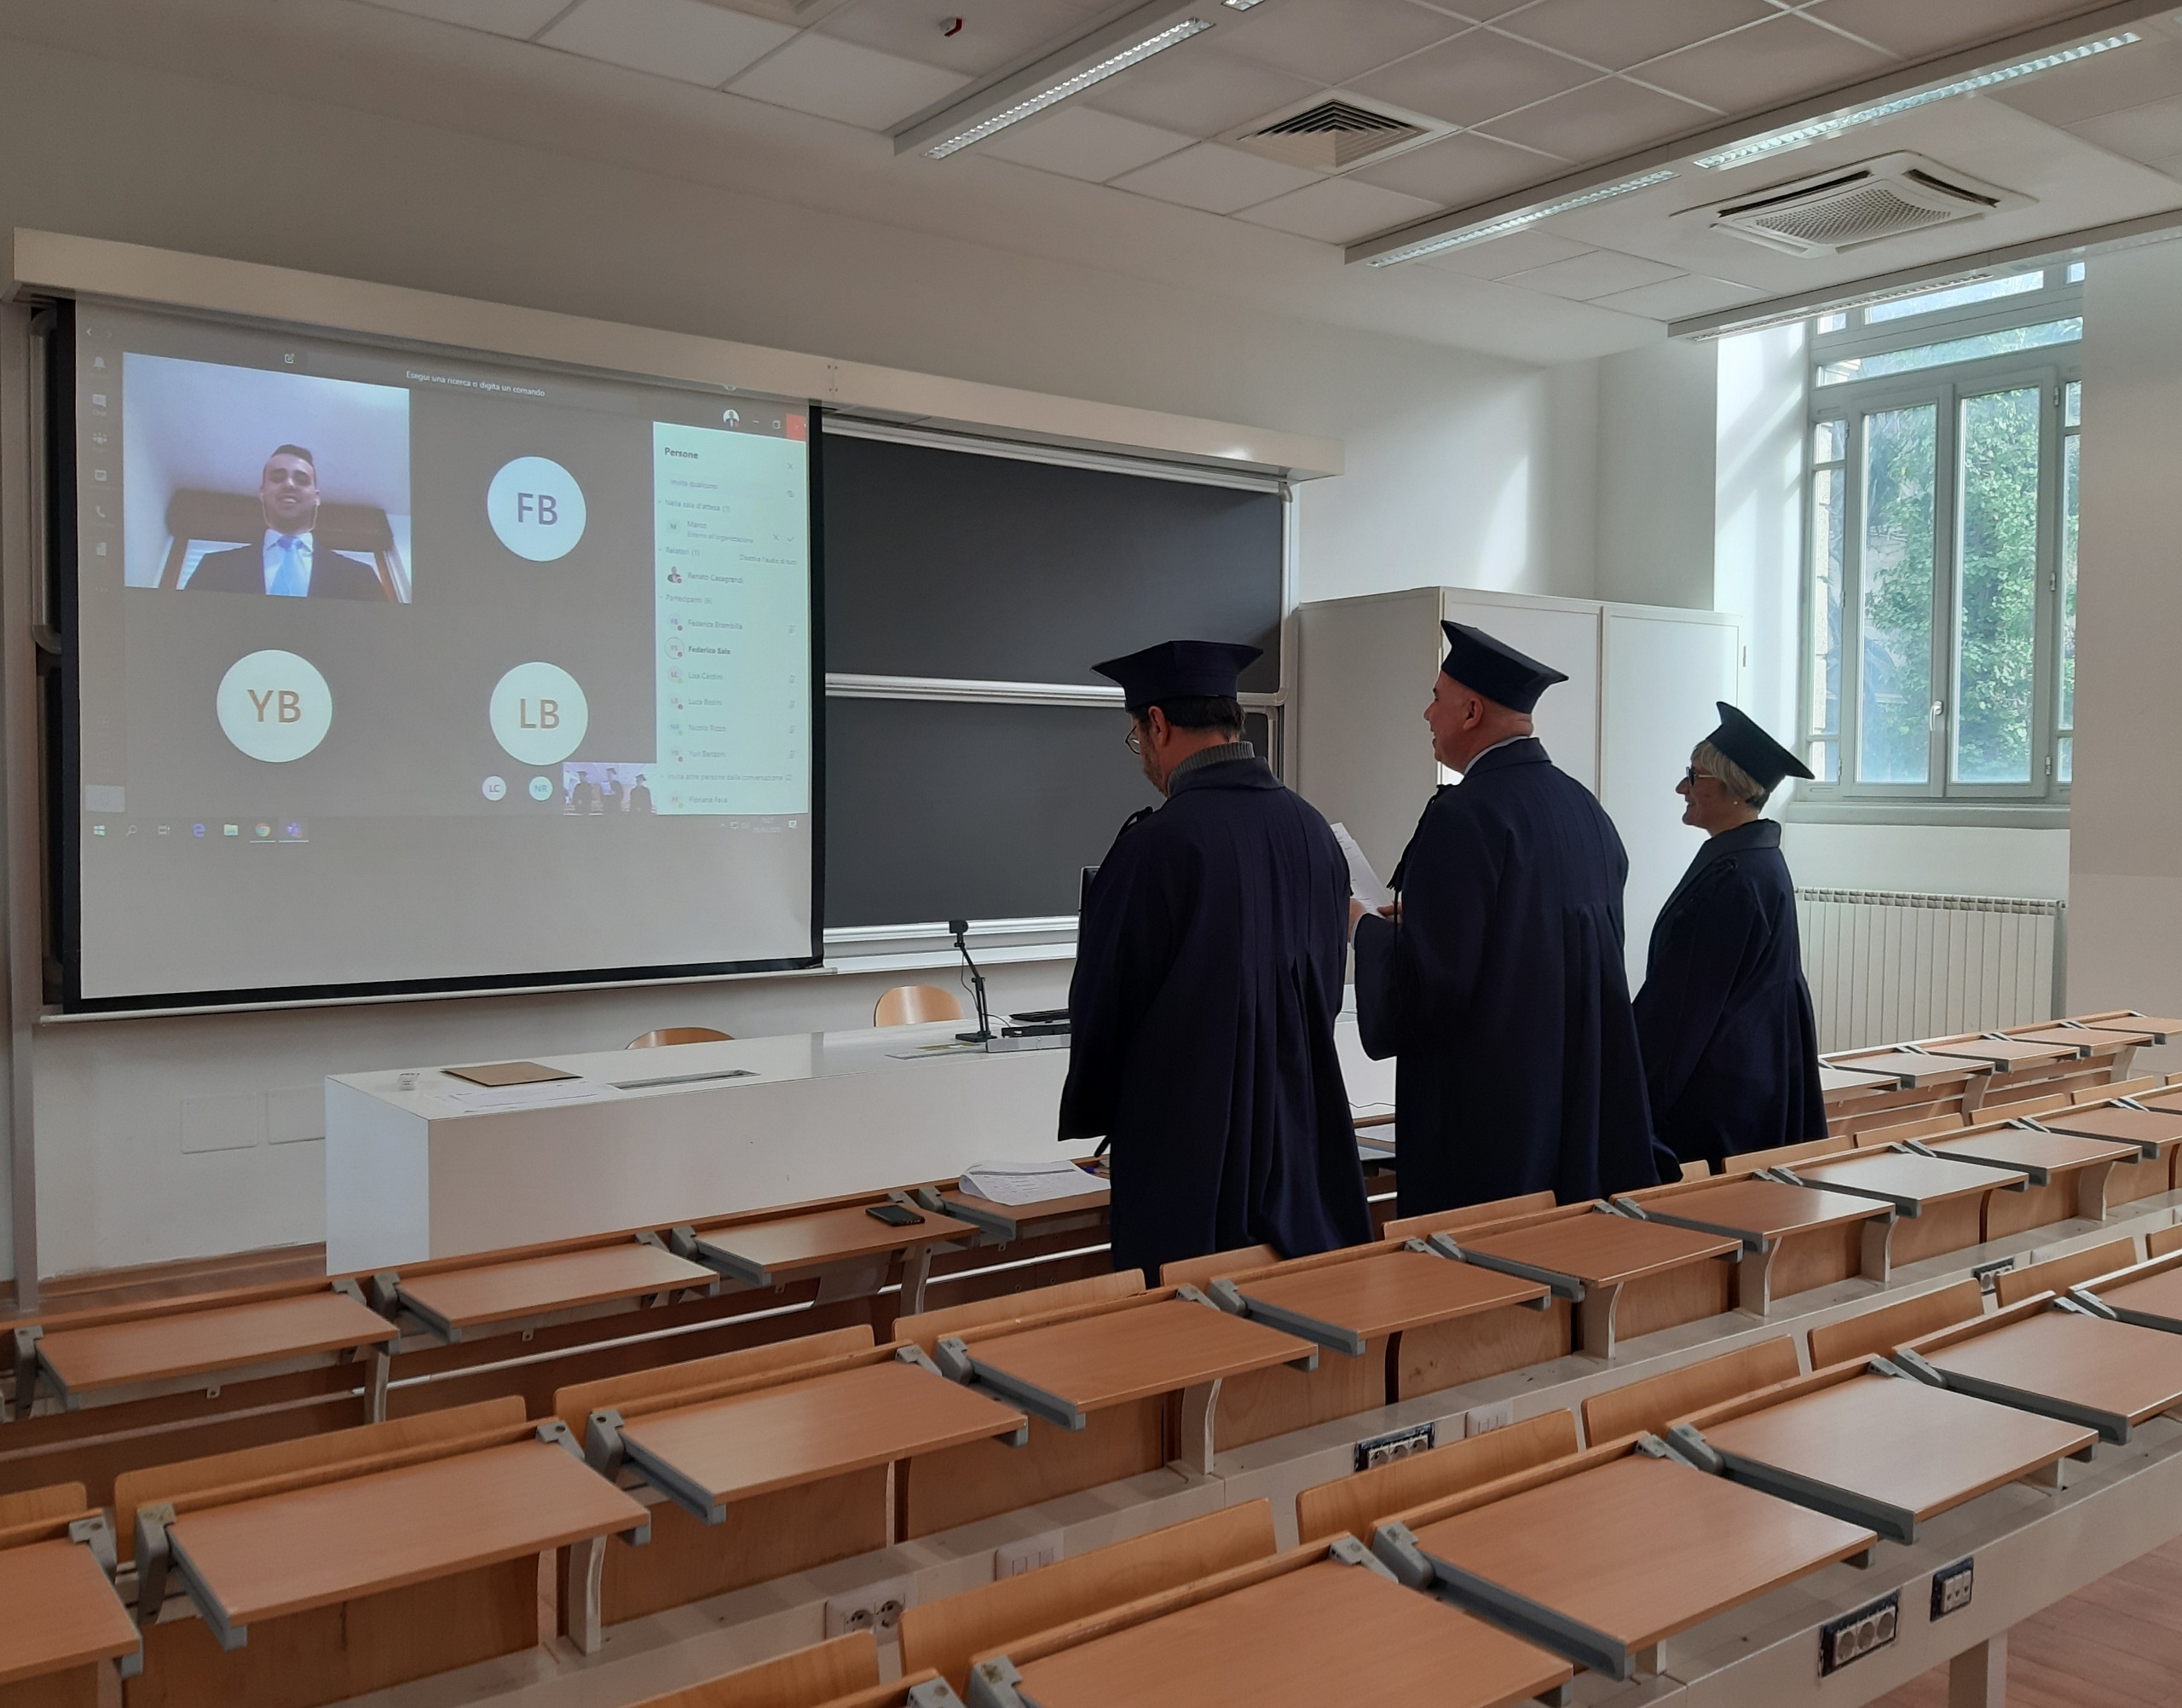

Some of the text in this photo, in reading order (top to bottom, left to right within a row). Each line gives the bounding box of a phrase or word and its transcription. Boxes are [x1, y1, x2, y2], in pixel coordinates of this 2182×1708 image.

[406, 370, 430, 381] Esegui
[432, 376, 446, 384] una
[447, 378, 470, 388] ricerca
[479, 381, 500, 391] digita
[512, 387, 546, 397] comando
[664, 447, 699, 460] Persone
[517, 493, 558, 525] FB
[687, 521, 707, 529] Marco
[688, 645, 716, 655] Federico
[247, 689, 301, 724] YB
[520, 698, 560, 729] LB
[488, 784, 500, 793] LC
[534, 784, 548, 793] NR
